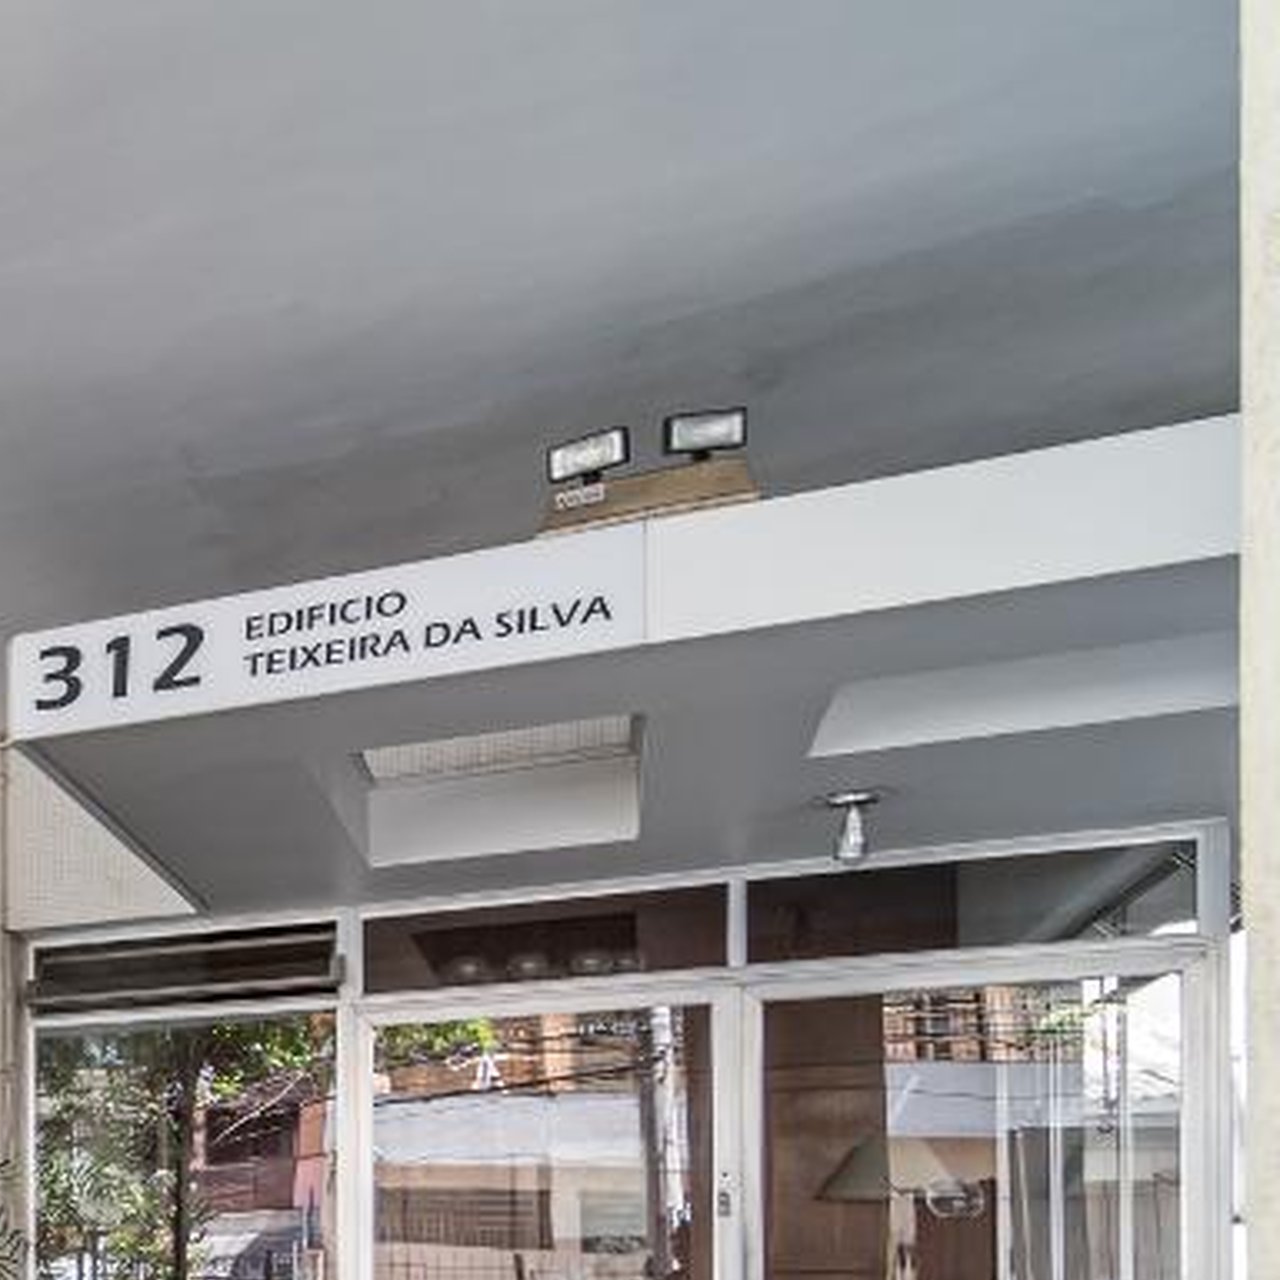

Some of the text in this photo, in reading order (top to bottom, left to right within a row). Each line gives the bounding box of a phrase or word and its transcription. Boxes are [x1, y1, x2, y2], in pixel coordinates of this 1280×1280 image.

[242, 595, 613, 677] TEIXEIRA DA SILVA
[244, 590, 408, 641] EDIFICIO
[34, 622, 206, 711] 312
